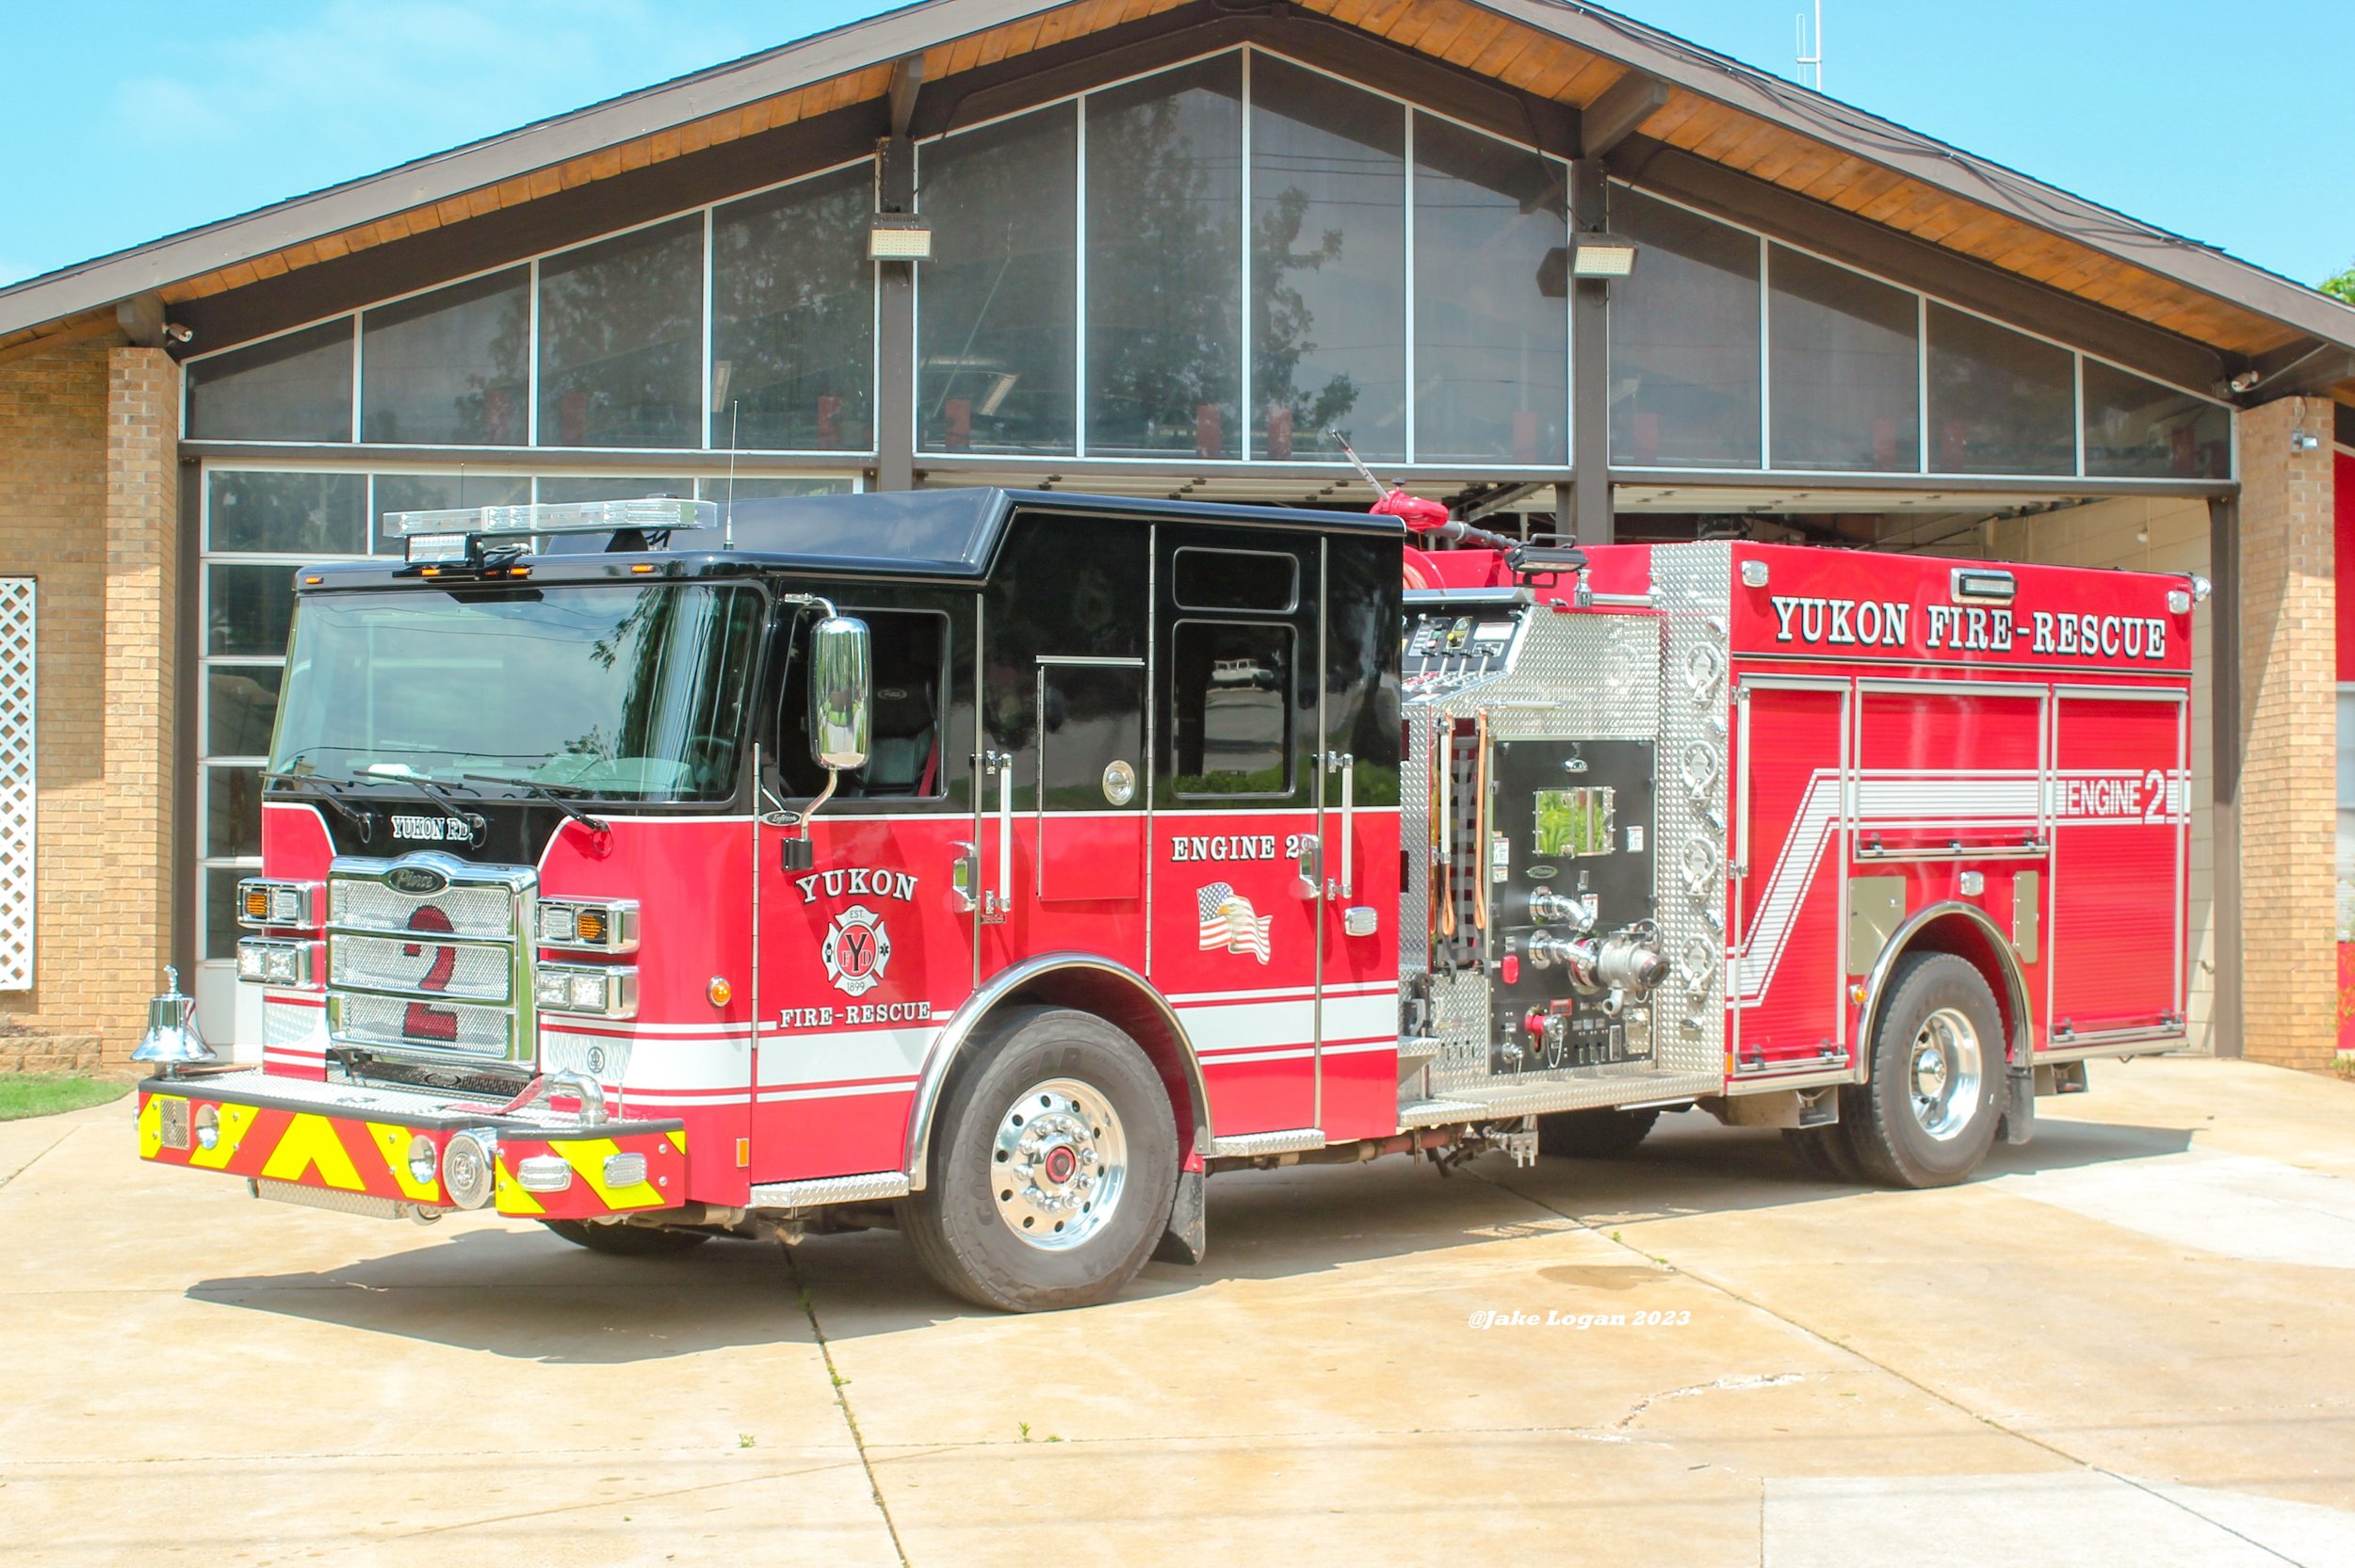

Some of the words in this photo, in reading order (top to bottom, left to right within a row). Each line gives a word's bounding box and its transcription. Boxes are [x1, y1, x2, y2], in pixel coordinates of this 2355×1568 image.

[1771, 595, 1909, 645] YUKON
[1926, 605, 2166, 658] FIRE-RESCUE
[2067, 779, 2142, 816] ENGINE
[2144, 768, 2166, 824] 2
[391, 816, 445, 840] YUKON
[1171, 835, 1275, 862] ENGINE
[1285, 834, 1300, 860] 2
[795, 867, 918, 904] YUKON
[403, 905, 458, 1042] 2
[847, 981, 866, 992] 1899
[780, 1001, 931, 1027] FIRE-RESCUE
